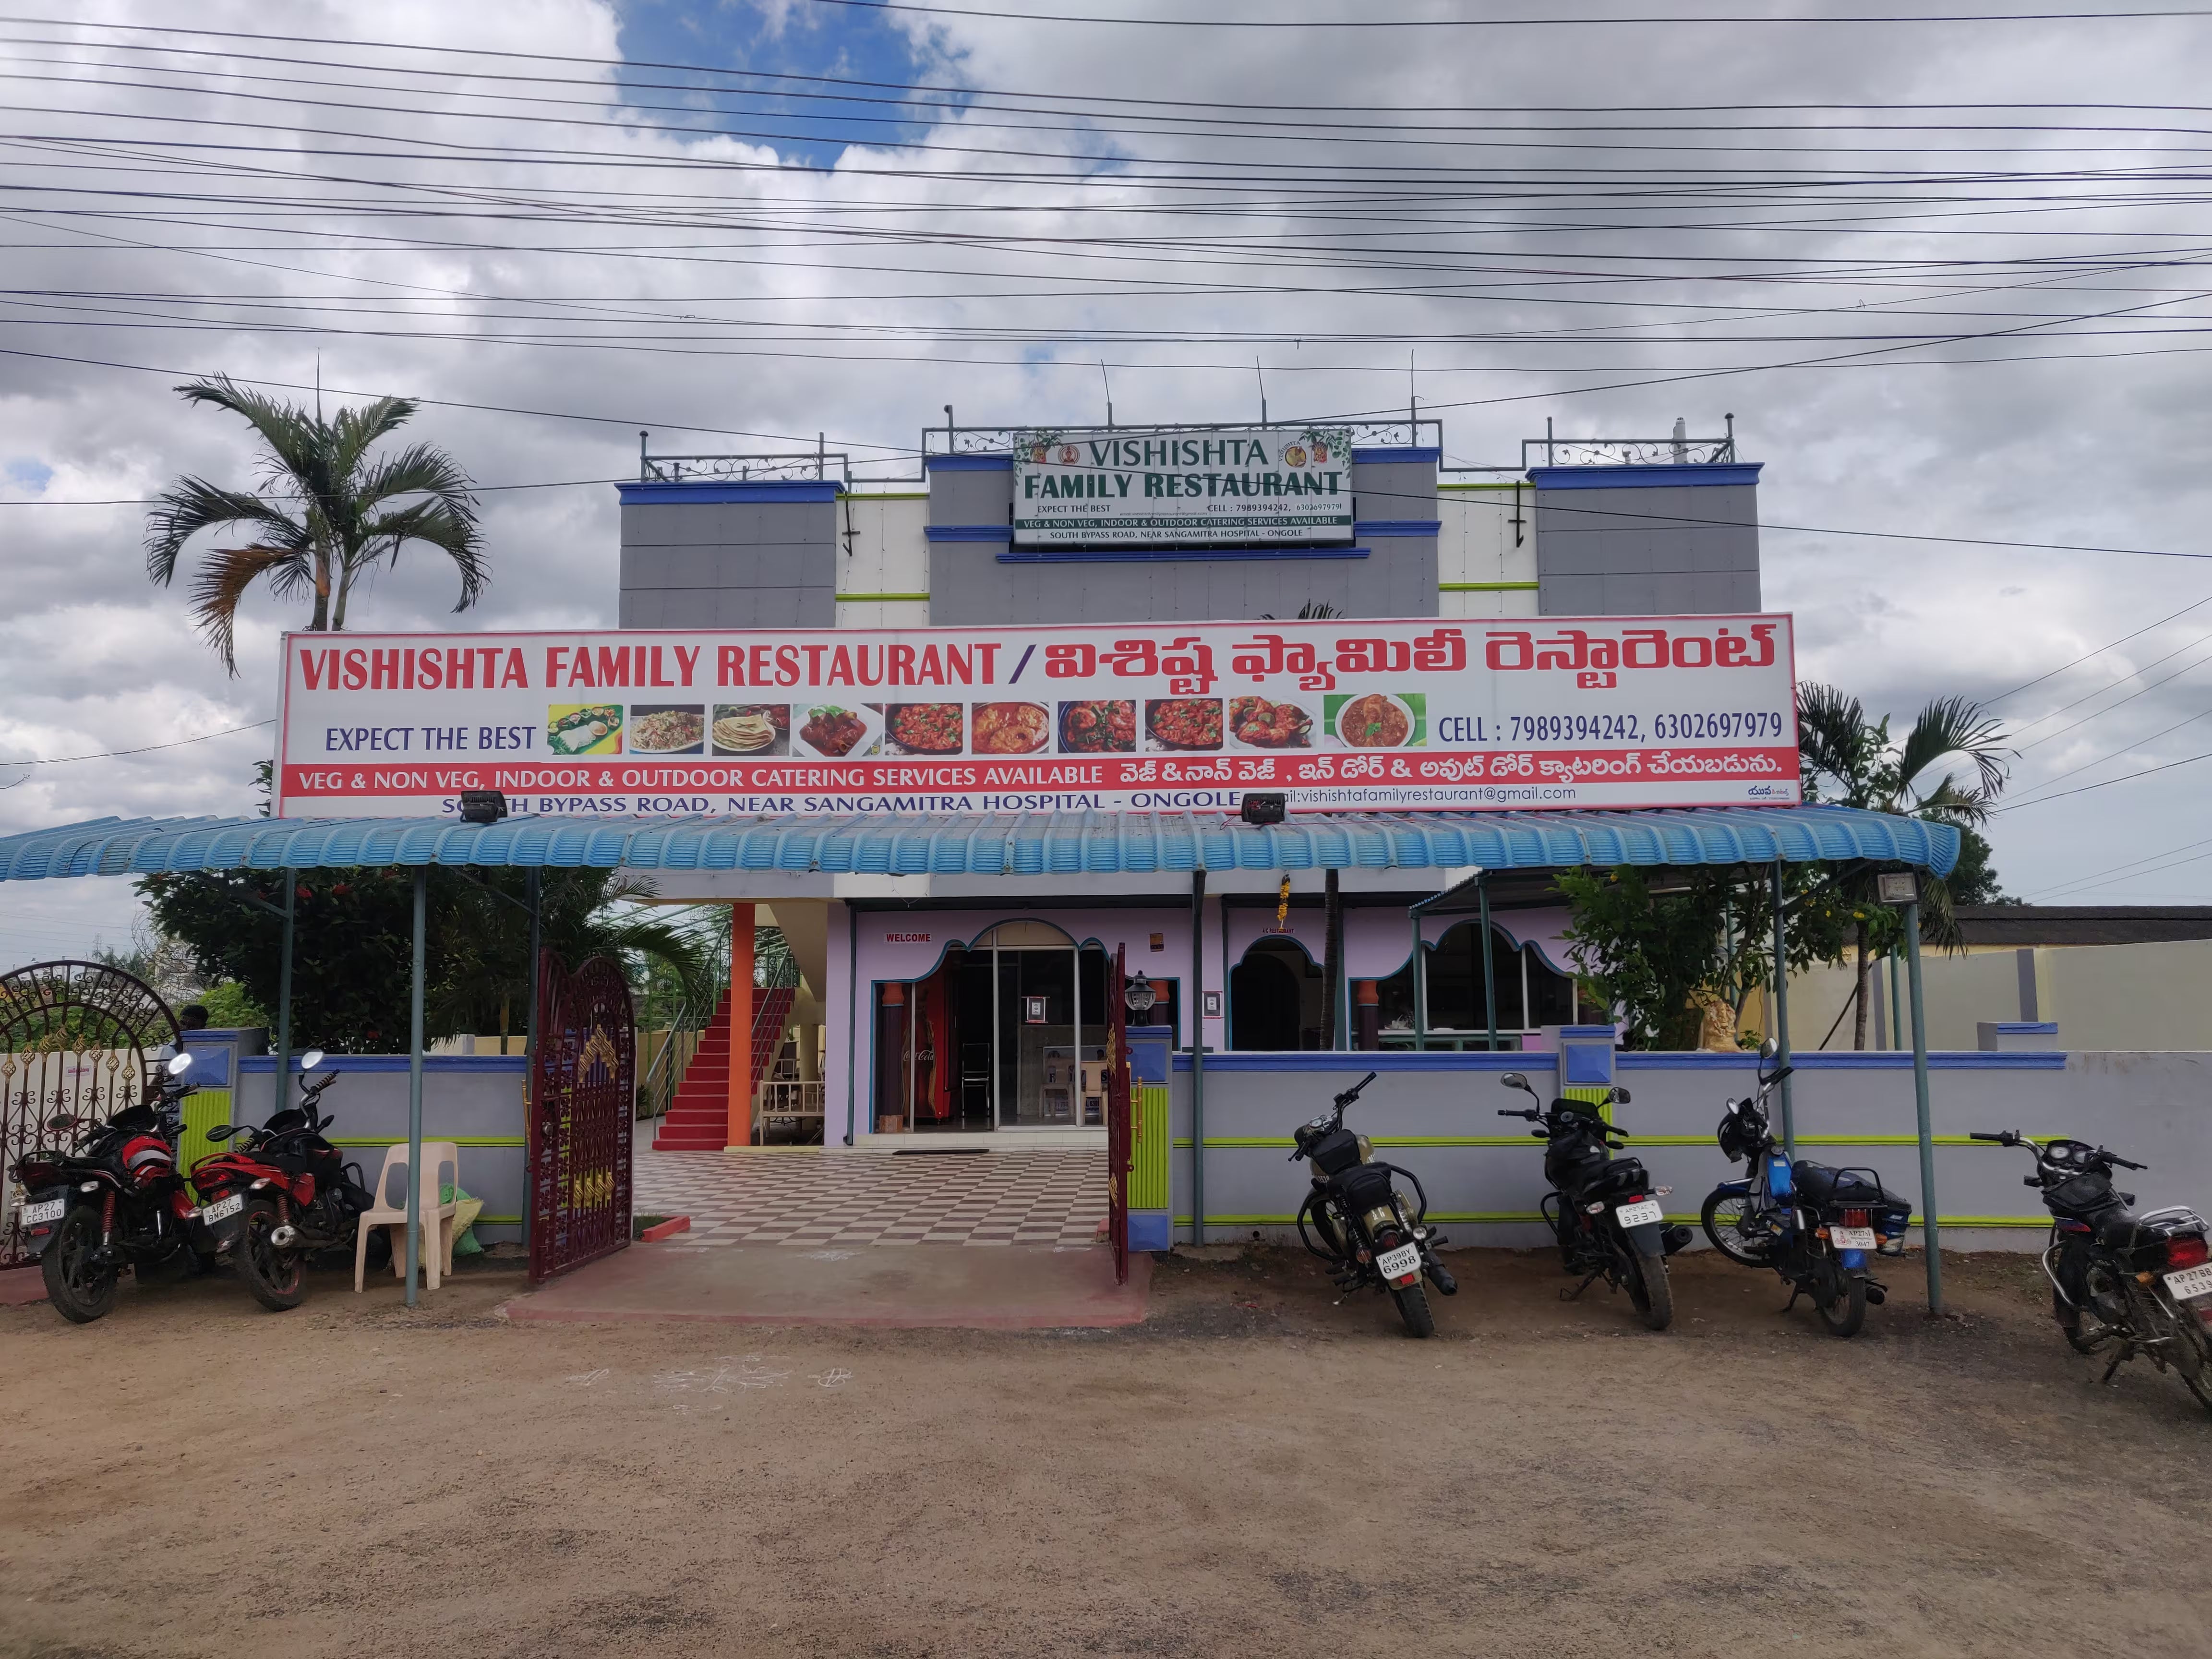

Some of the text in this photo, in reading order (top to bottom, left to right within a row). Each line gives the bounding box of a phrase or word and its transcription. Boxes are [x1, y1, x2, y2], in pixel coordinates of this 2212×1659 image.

[1088, 440, 1269, 466] VISHISHTA
[1024, 471, 1343, 499] FAMILY RESTAURANT
[1077, 519, 1097, 529] VEG,
[1150, 518, 1198, 527] OUTDOOR
[1290, 517, 1337, 525] AVAILABLE
[1112, 530, 1138, 539] ROAD,
[1141, 530, 1162, 538] NEAR
[1485, 624, 1777, 689] రెస్టారెంట్
[300, 647, 529, 690] VISHISHTA
[546, 645, 701, 688] FAMILY
[717, 643, 1001, 687] RESTAURANT
[1439, 717, 1488, 743] CELL
[1510, 714, 1646, 743] 7989394242,
[1654, 712, 1782, 740] 6302697979
[325, 726, 537, 751] EXPECT THE BEST
[1120, 761, 1157, 782] వెజ్
[1238, 758, 1276, 781] వెజ్
[1298, 757, 1334, 780] ఇన్
[1341, 755, 1384, 779] డోర్
[1391, 759, 1413, 778] &
[1490, 753, 1534, 777] డోర్
[299, 766, 1103, 791] VEG & NON VEG, INDOOR & OUTDOOR CATERING SERVICES AVAILABLE
[540, 797, 626, 812] BYPASS
[637, 797, 716, 815] ROAD,
[728, 797, 795, 812] NEAR
[804, 796, 973, 812] SANGAMITRA
[983, 794, 1105, 810] HOSPITAL
[1130, 792, 1240, 807] ONGOLE
[886, 934, 931, 942] WELCOME
[32, 1202, 55, 1214] AP27
[209, 1203, 240, 1222] BN6152
[212, 1199, 231, 1213] AP27
[27, 1209, 61, 1223] CC3100
[1624, 1211, 1656, 1224] 9237
[1382, 1248, 1410, 1265] AP39BY
[1383, 1256, 1416, 1274] 6998
[2184, 1281, 2212, 1294] 6539
